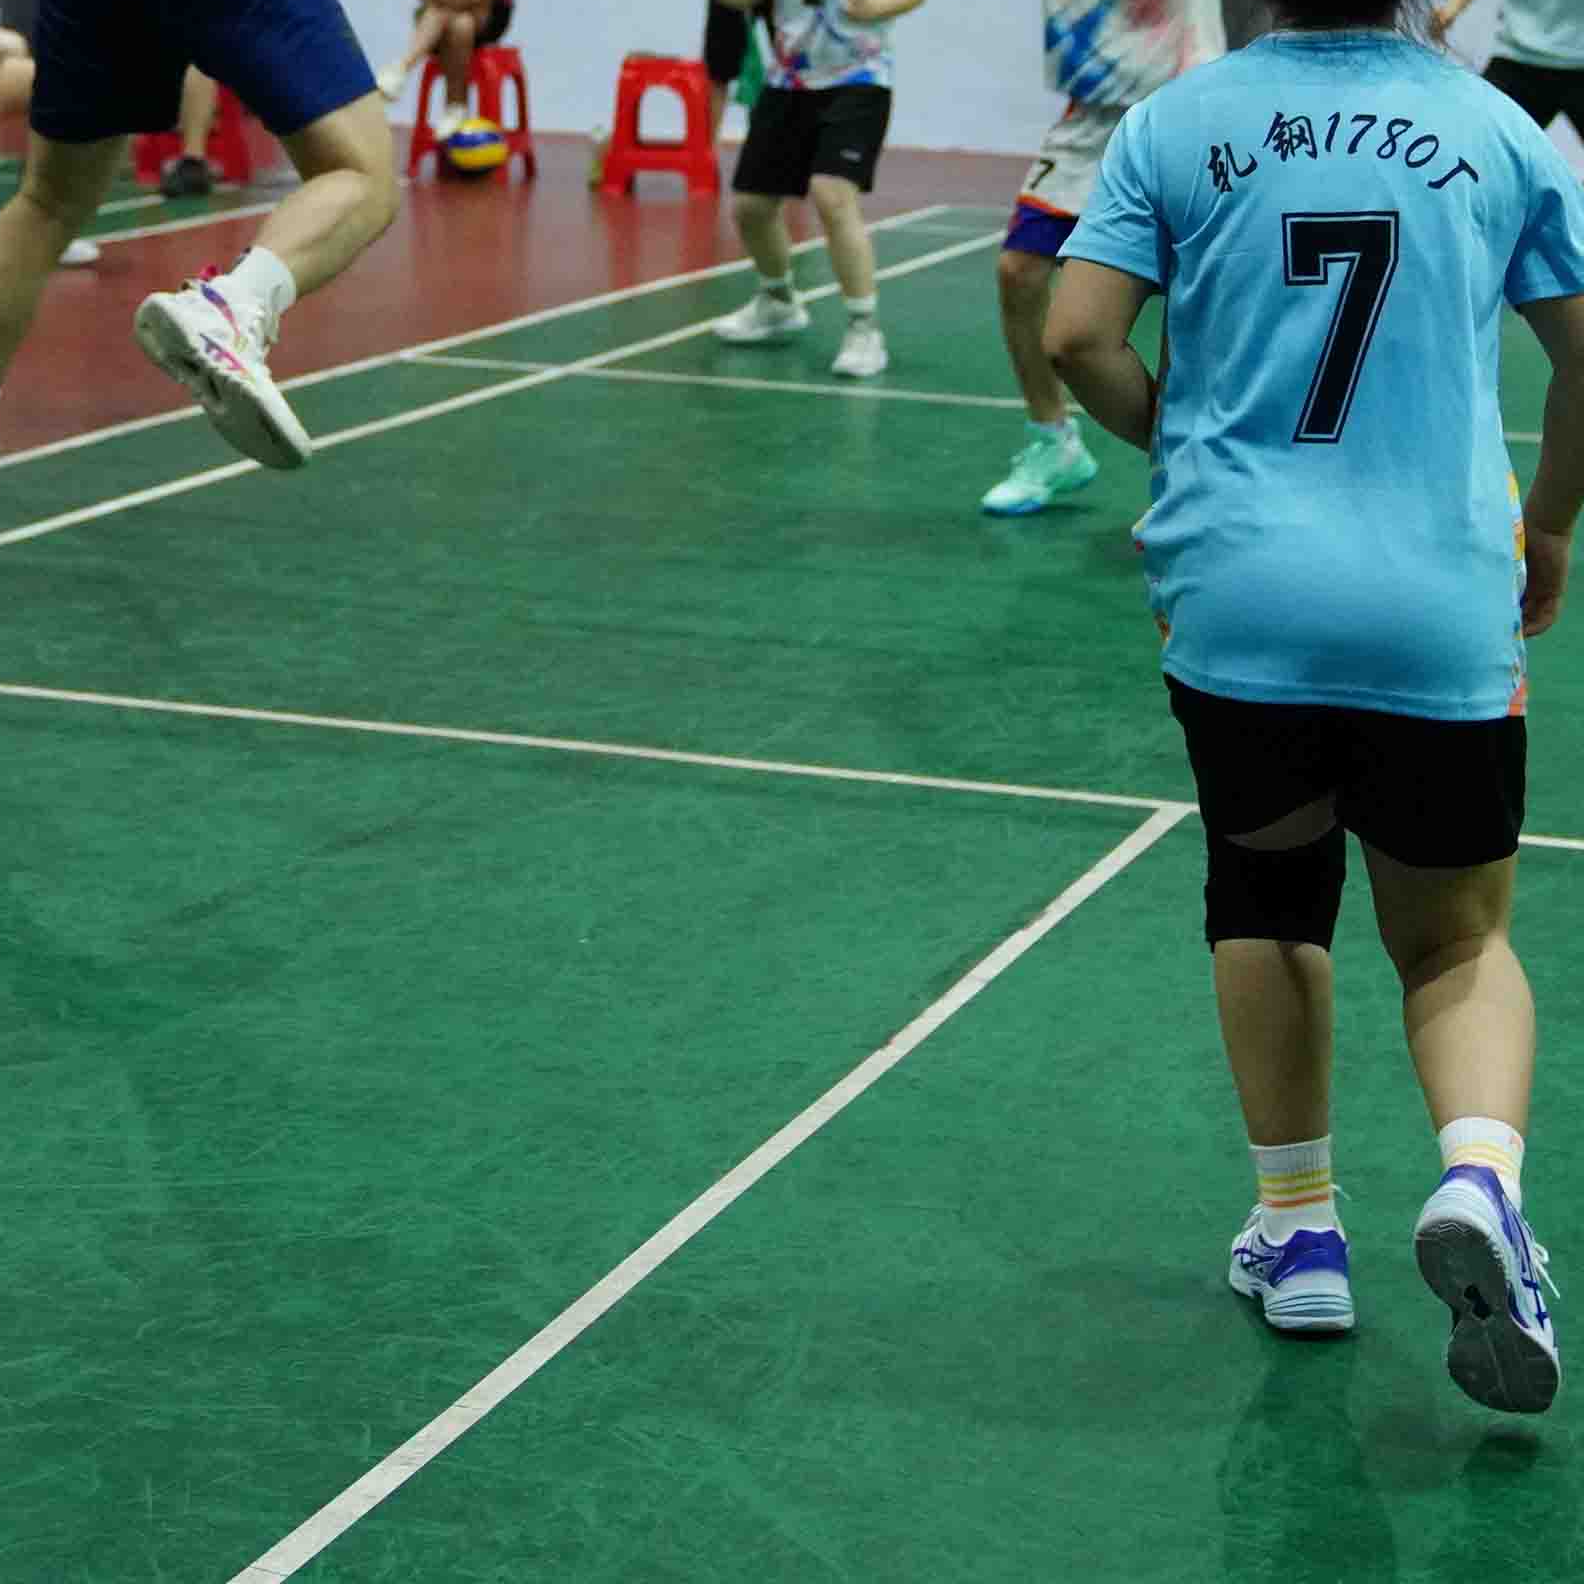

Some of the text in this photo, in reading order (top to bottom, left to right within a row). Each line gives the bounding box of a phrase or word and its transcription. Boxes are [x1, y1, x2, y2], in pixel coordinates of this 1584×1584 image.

[1029, 158, 1056, 191] 7
[1208, 111, 1479, 193] 轧钢1780厂
[1280, 210, 1400, 444] 7
